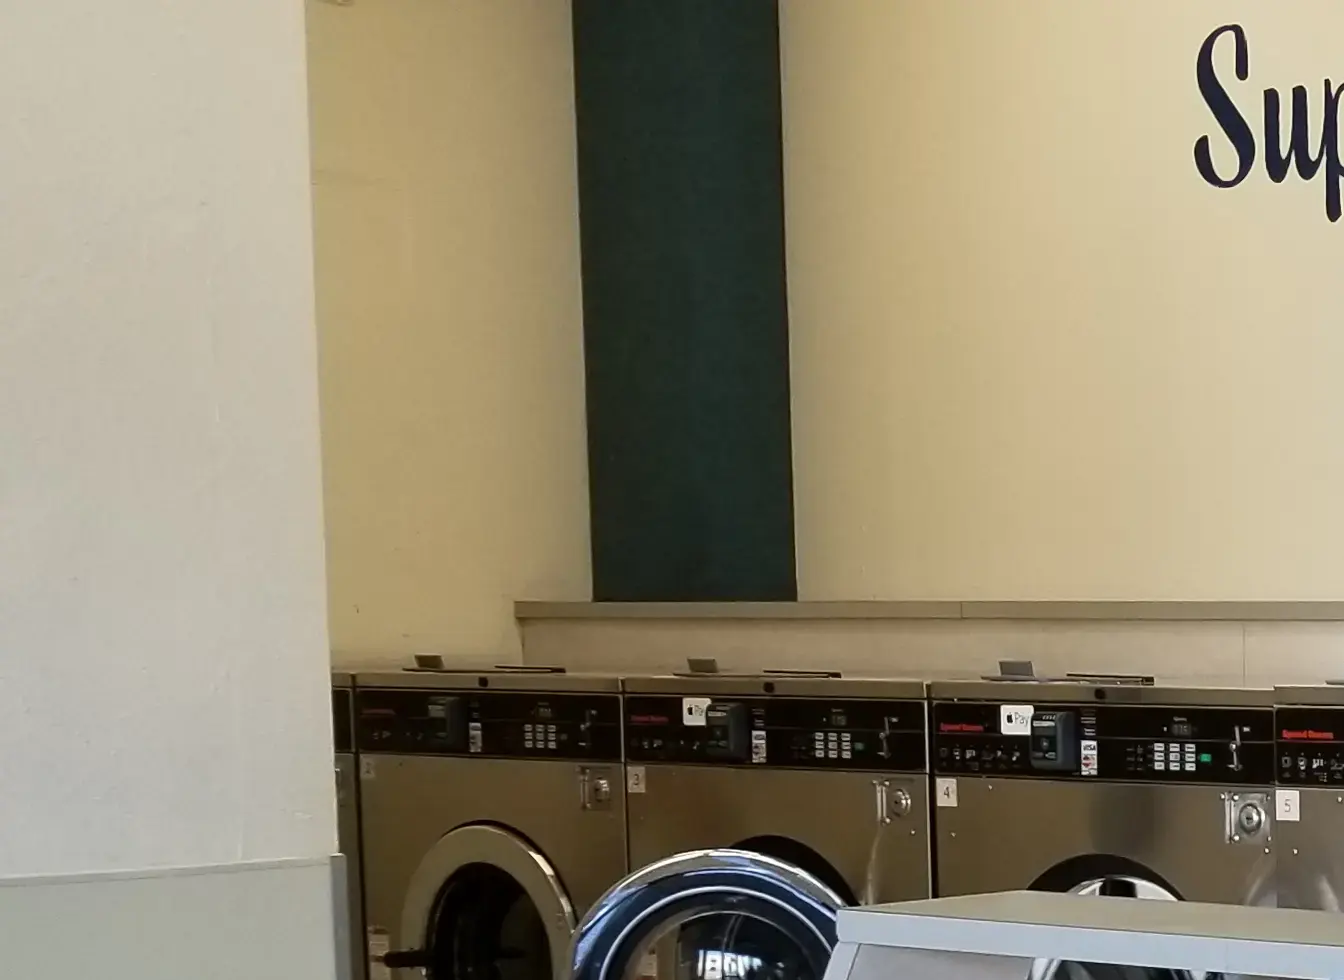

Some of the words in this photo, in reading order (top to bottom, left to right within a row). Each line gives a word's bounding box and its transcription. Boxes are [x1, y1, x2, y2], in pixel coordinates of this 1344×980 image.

[1014, 712, 1029, 727] Pay
[943, 786, 950, 799] 4
[1284, 798, 1291, 812] 5
